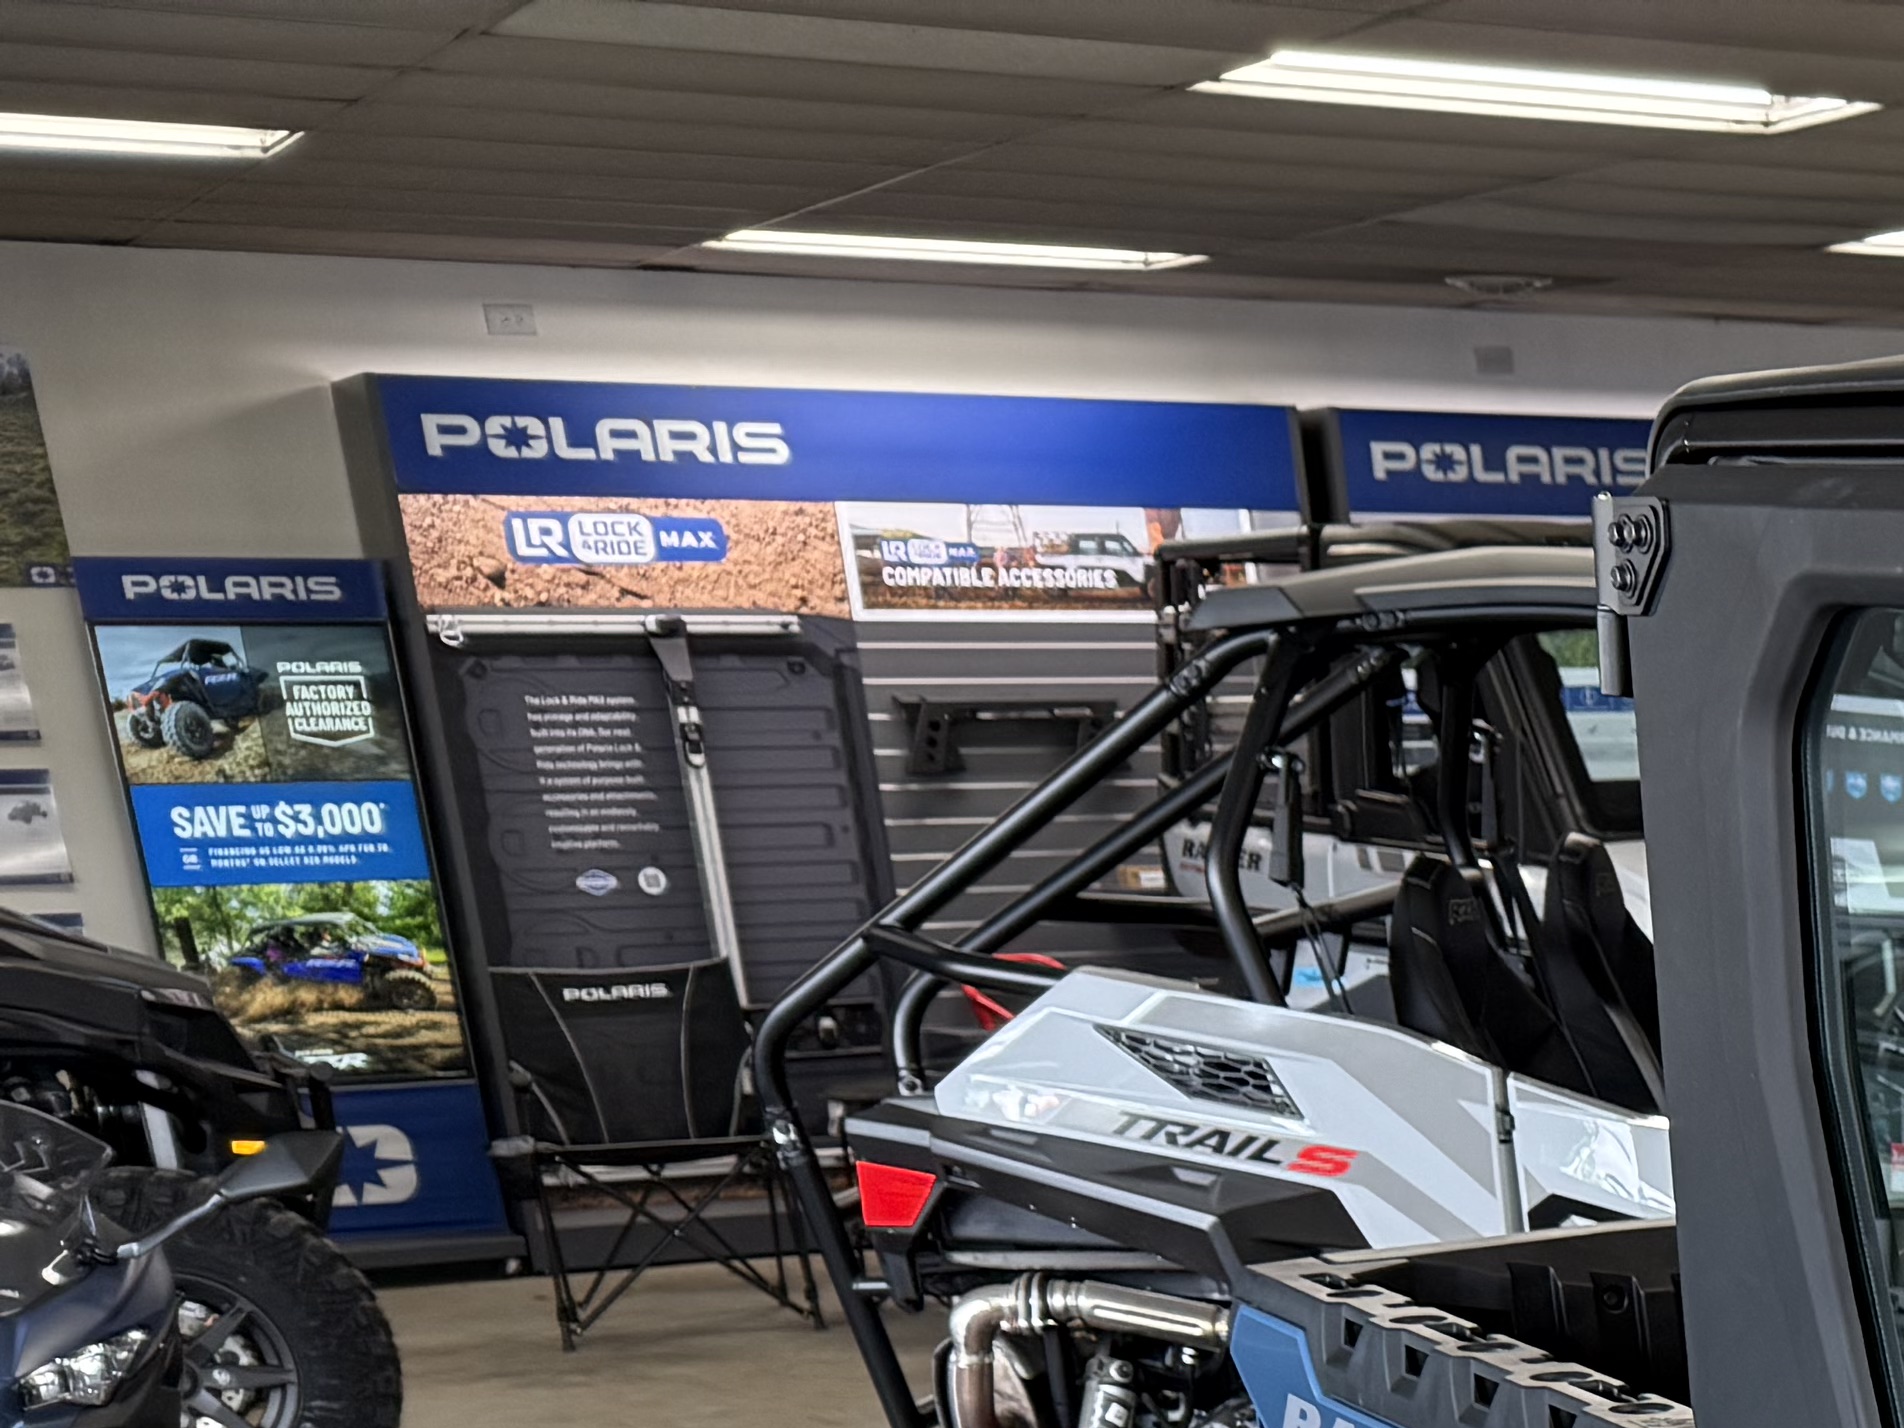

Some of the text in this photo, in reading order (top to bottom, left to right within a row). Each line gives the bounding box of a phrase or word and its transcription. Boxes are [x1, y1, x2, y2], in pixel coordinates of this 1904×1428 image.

[420, 413, 791, 466] POLARIS
[1369, 441, 1649, 487] POLARIS
[579, 520, 644, 538] LOCK
[599, 530, 660, 550] MAX
[121, 574, 343, 601] POLARIS
[882, 566, 1119, 589] COMPATIBLE ACCESSORIES
[276, 661, 363, 674] POLARIS
[292, 684, 355, 701] FACTORY
[285, 701, 372, 717] AUTHORIZED
[294, 717, 368, 732] CLEARANCE
[251, 804, 271, 820] UP
[170, 806, 251, 839] SAVE
[254, 821, 275, 838] TO
[562, 982, 670, 1002] POLARIS
[1113, 1110, 1359, 1177] TRAIL S
